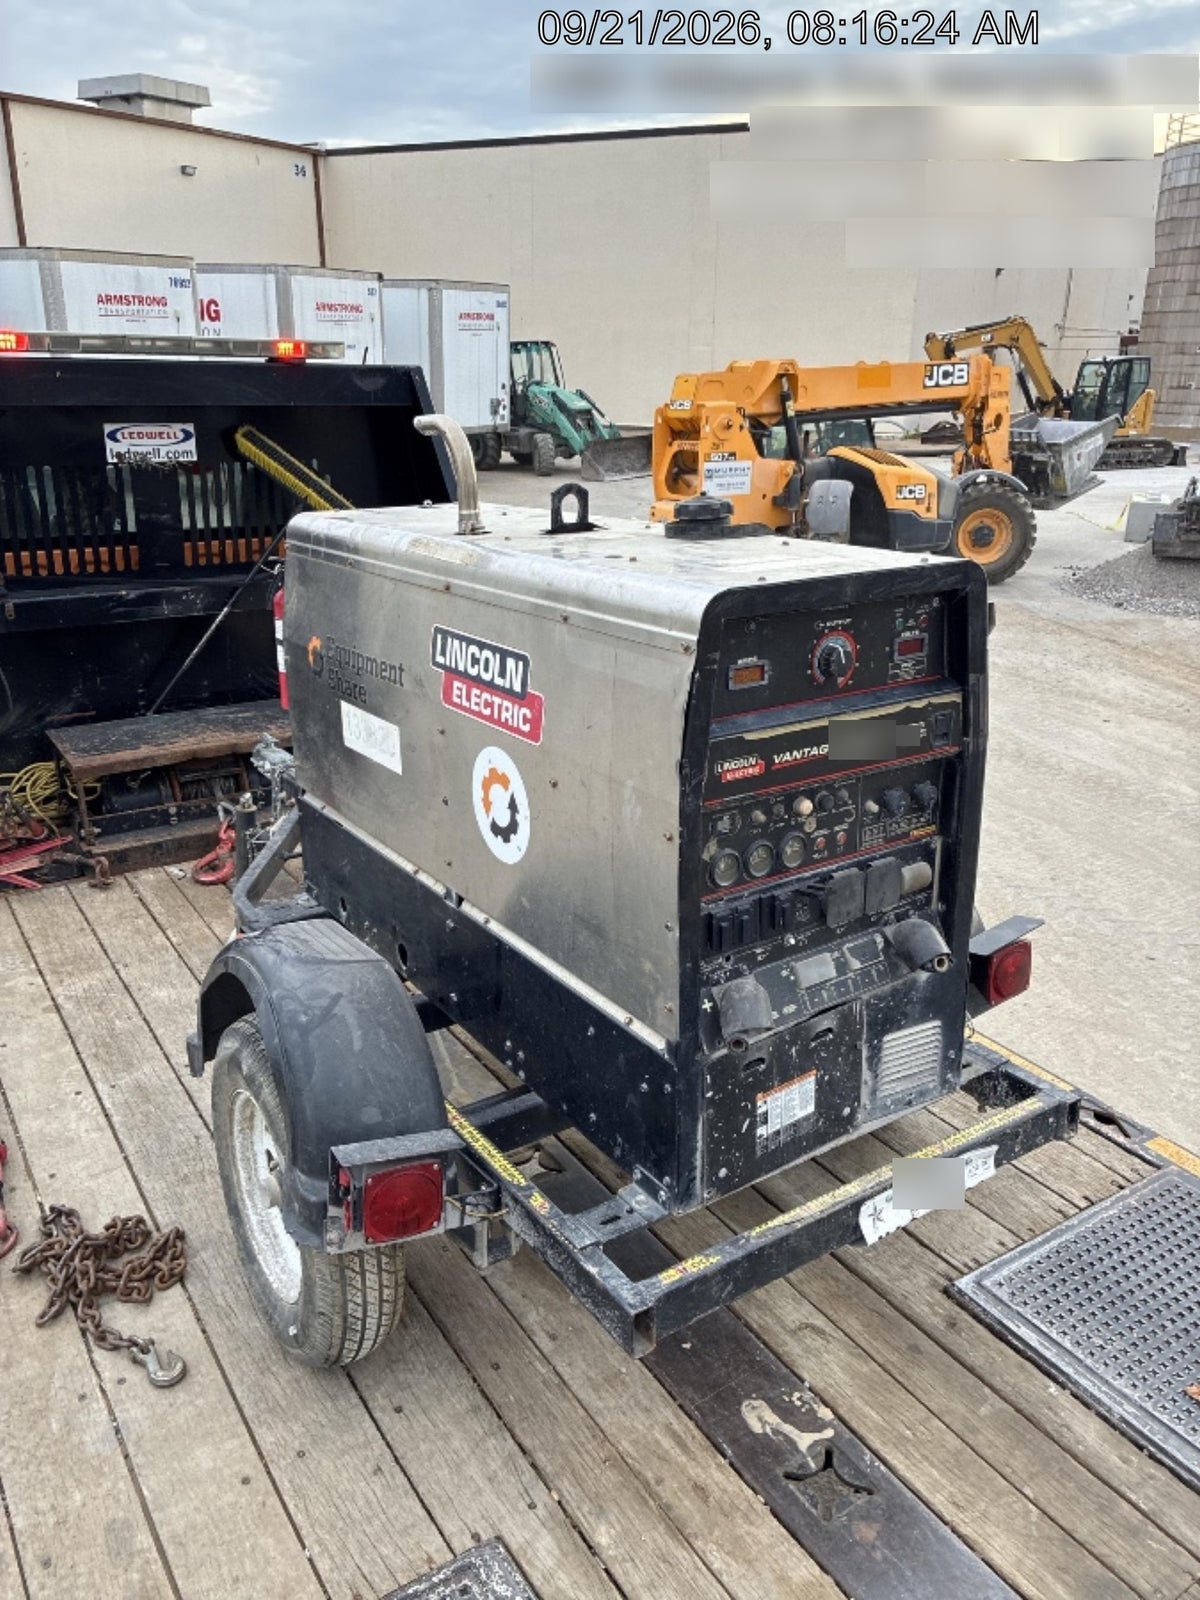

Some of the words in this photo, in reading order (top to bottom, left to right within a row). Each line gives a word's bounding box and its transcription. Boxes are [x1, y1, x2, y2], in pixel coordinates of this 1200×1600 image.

[97, 293, 168, 308] ARMSTRONG
[315, 301, 364, 314] ARMSTRONG
[923, 364, 969, 387] JCB
[669, 400, 692, 410] JCB
[121, 431, 180, 440] LEDWELL
[110, 447, 194, 461] ldwell.com
[896, 485, 926, 499] JCB
[326, 636, 405, 688] Equipment
[434, 633, 524, 693] LINCOLN
[452, 680, 532, 732] ELECTRIC
[773, 744, 829, 764] VANTAG
[718, 756, 757, 772] LINCOLN
